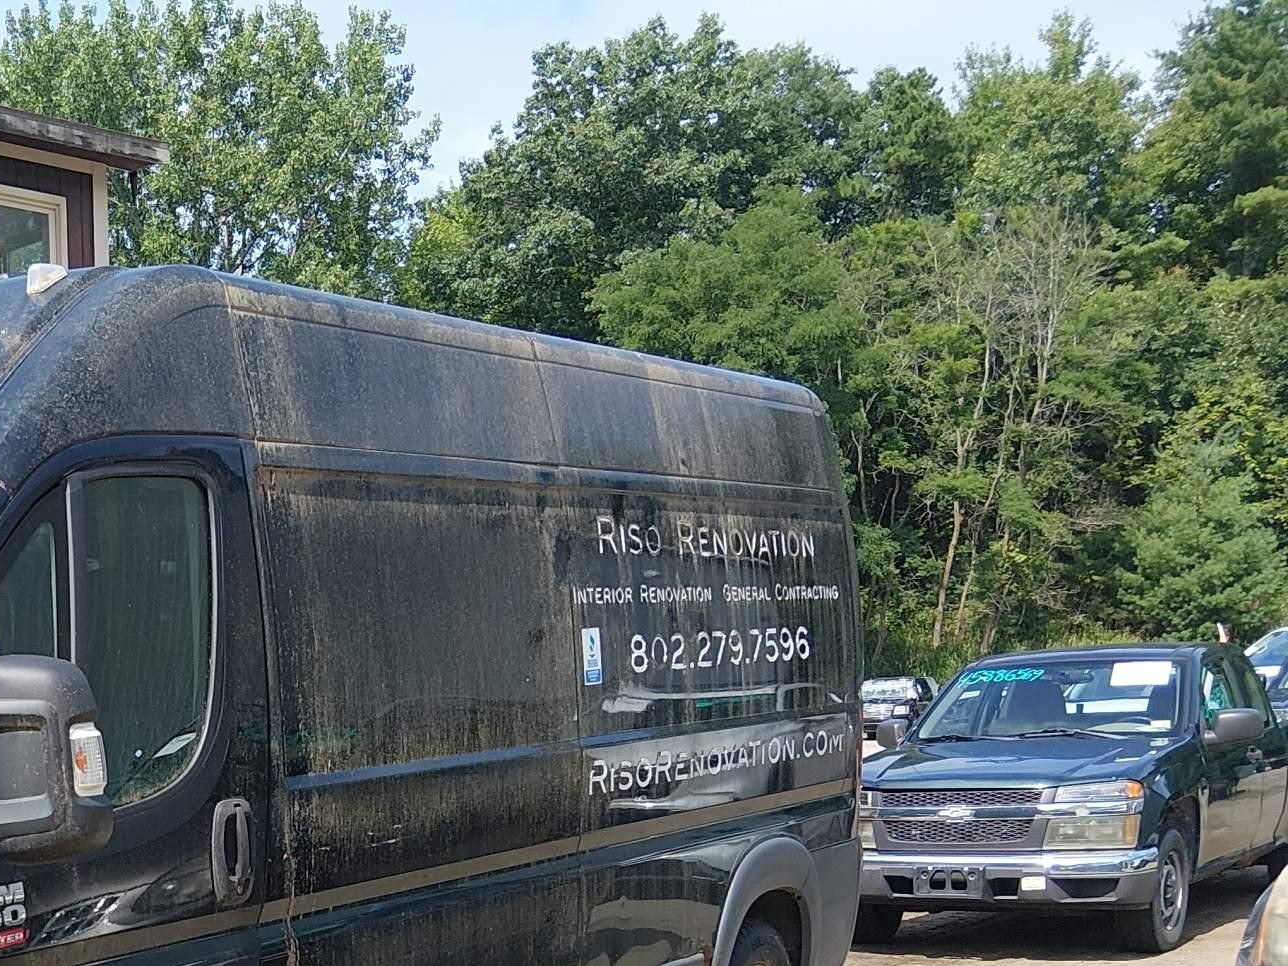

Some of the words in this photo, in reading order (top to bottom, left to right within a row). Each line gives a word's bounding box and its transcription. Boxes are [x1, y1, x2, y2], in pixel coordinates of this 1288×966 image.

[597, 516, 660, 555] RISO
[678, 519, 815, 558] RENOVATION
[573, 585, 632, 604] INTERIOR
[640, 584, 712, 603] RENOVATION
[722, 583, 771, 602] GENERAL
[774, 583, 839, 601] CONTRACTING
[631, 626, 810, 672] 802.279.7596
